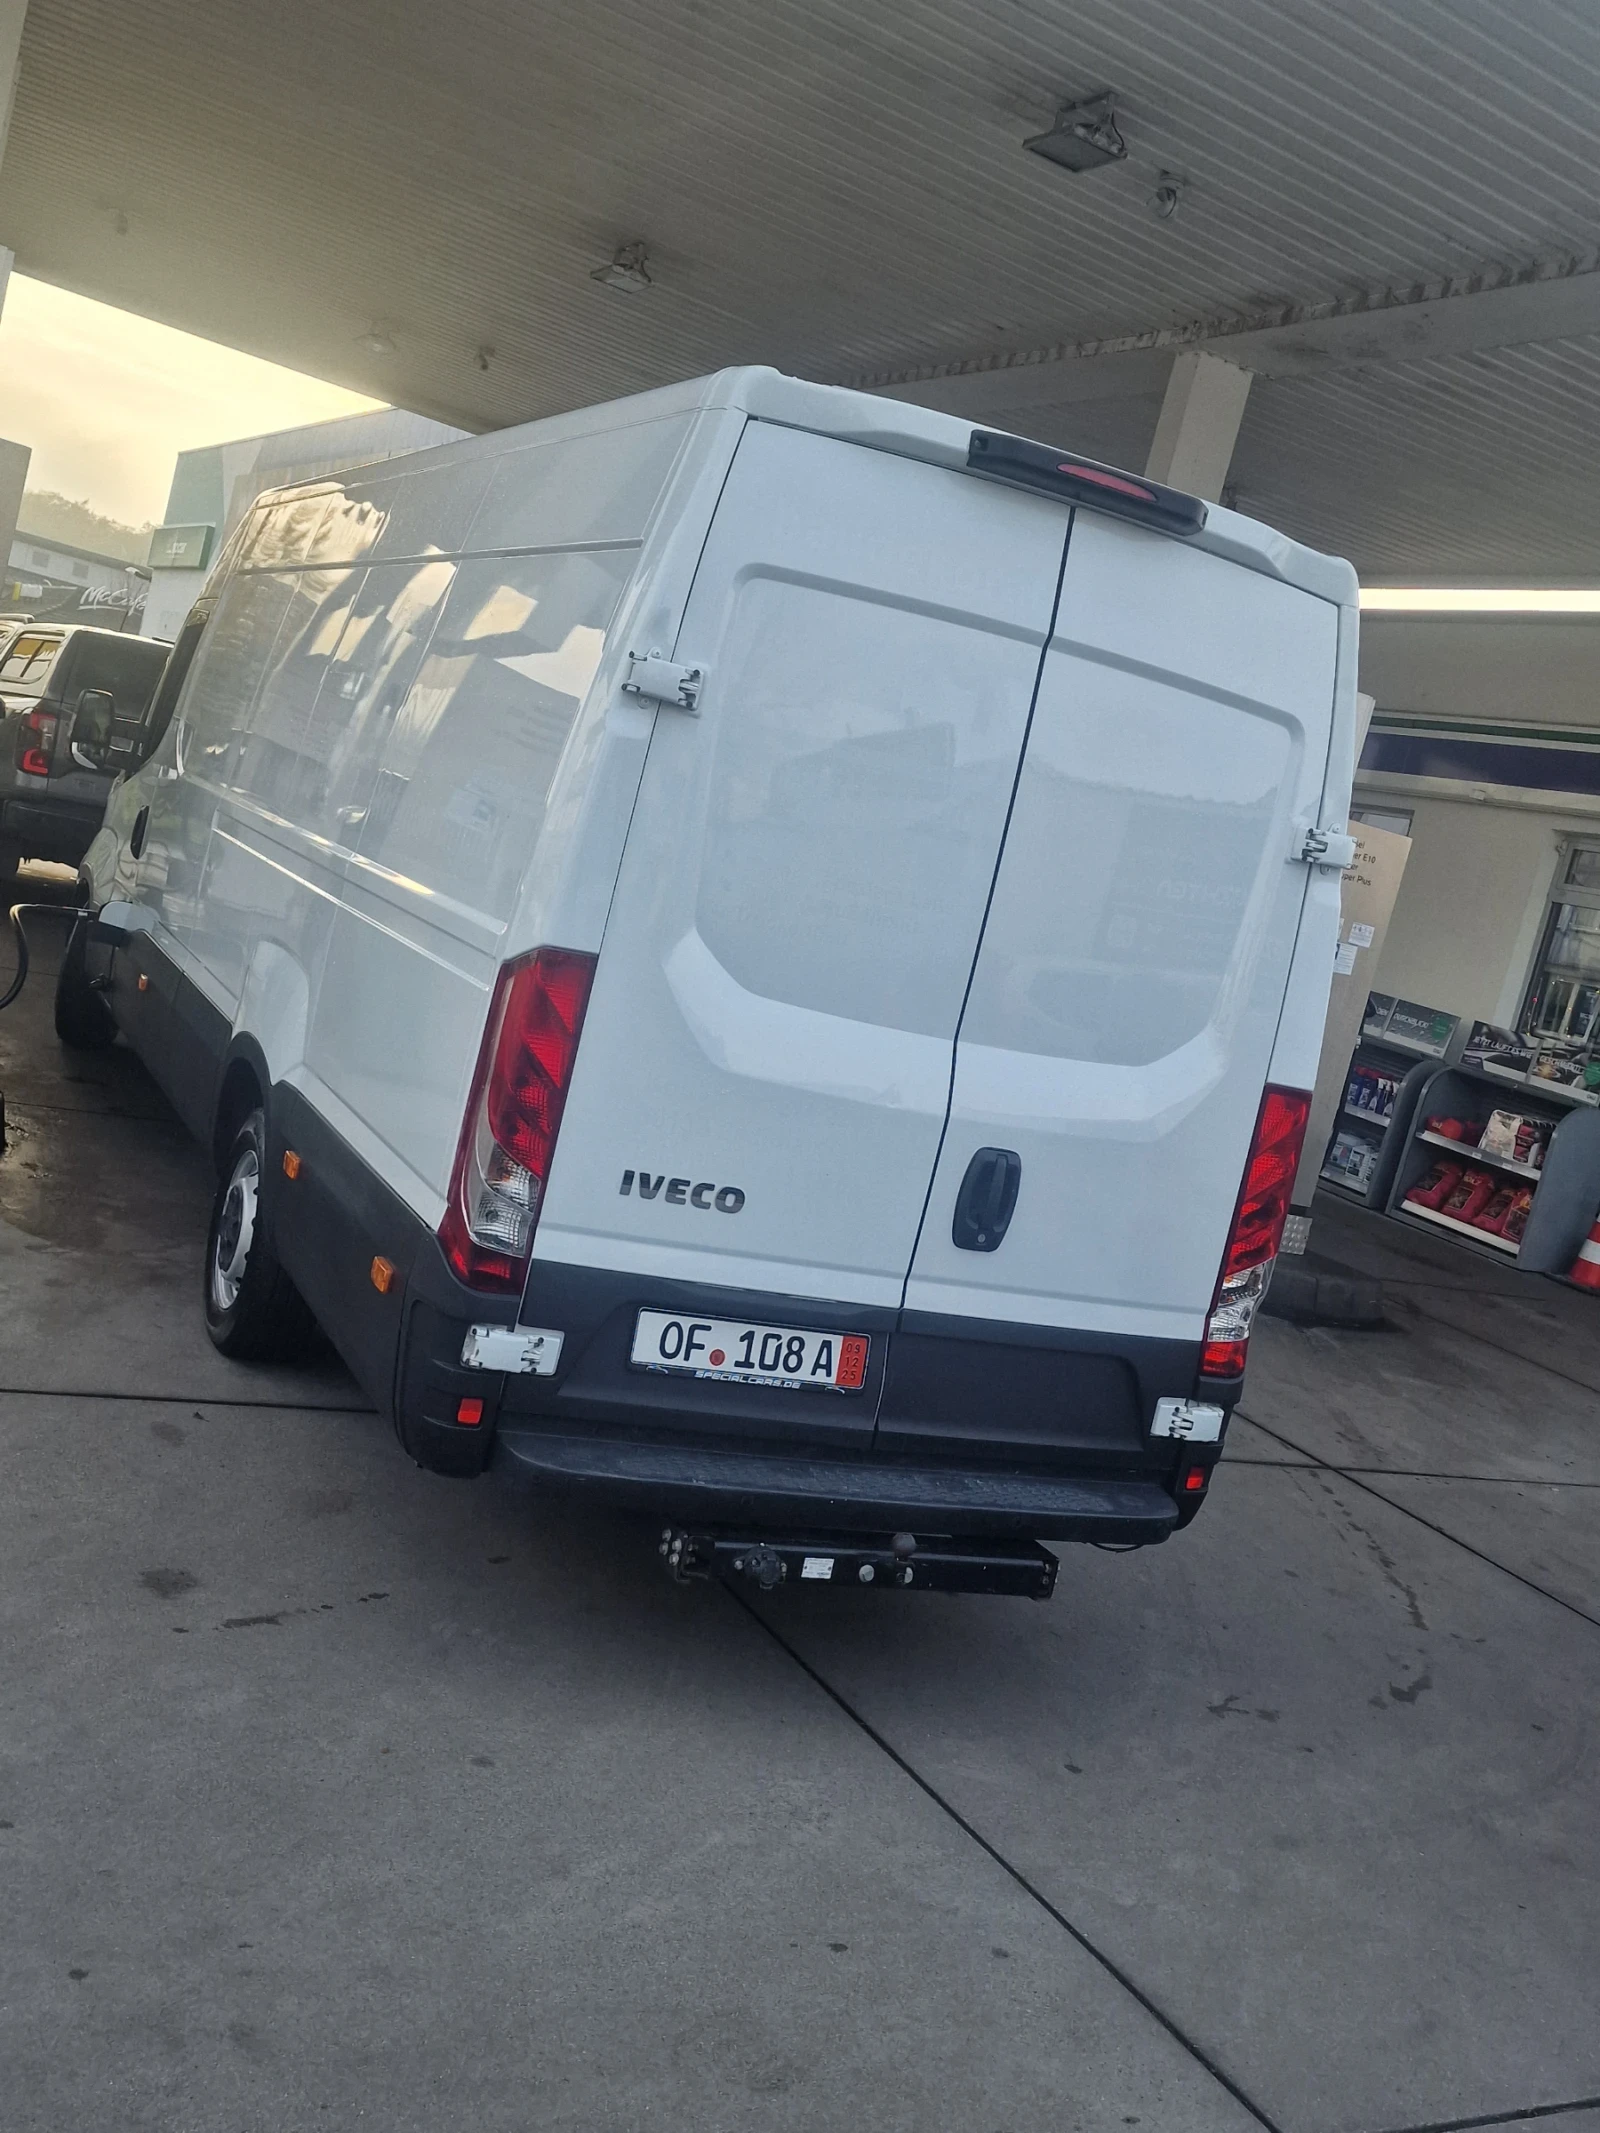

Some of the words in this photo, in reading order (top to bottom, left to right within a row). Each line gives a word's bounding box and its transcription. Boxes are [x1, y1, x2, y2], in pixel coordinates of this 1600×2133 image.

[1363, 853, 1376, 864] E10
[619, 1169, 746, 1214] IVECO
[659, 1320, 712, 1362] OF
[734, 1330, 804, 1373] 108
[811, 1339, 832, 1378] A
[845, 1356, 859, 1368] 12
[841, 1369, 857, 1381] 25
